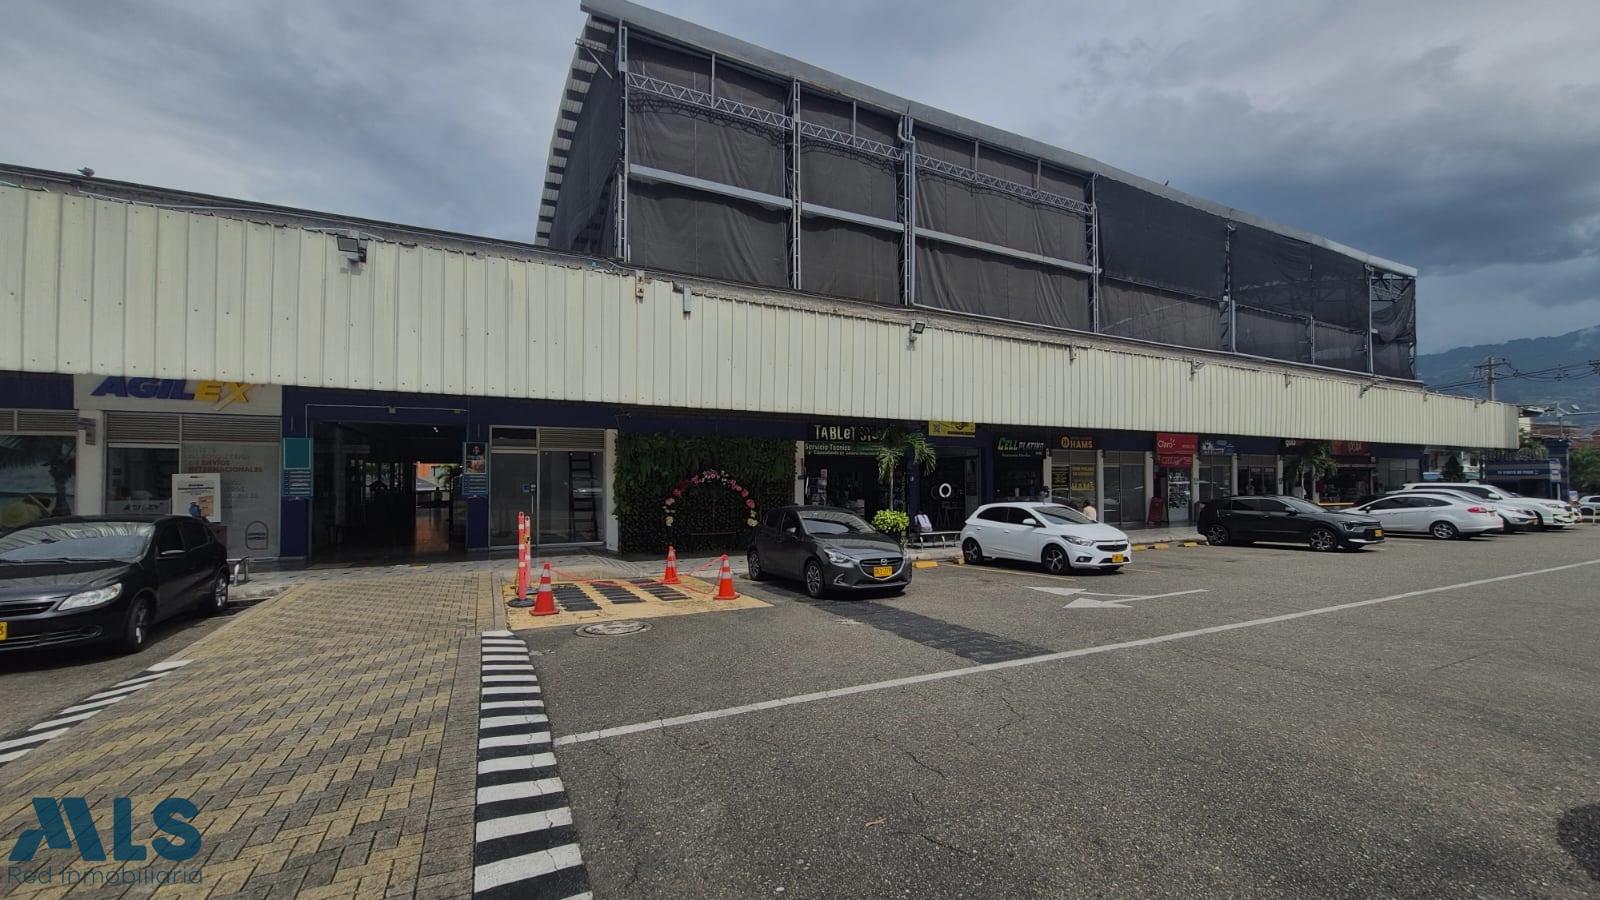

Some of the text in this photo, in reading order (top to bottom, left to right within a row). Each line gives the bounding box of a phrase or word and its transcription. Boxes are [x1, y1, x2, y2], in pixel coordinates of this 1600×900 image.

[91, 375, 251, 411] AGILEX
[997, 437, 1018, 450] CELL
[1070, 440, 1093, 449] HAMS
